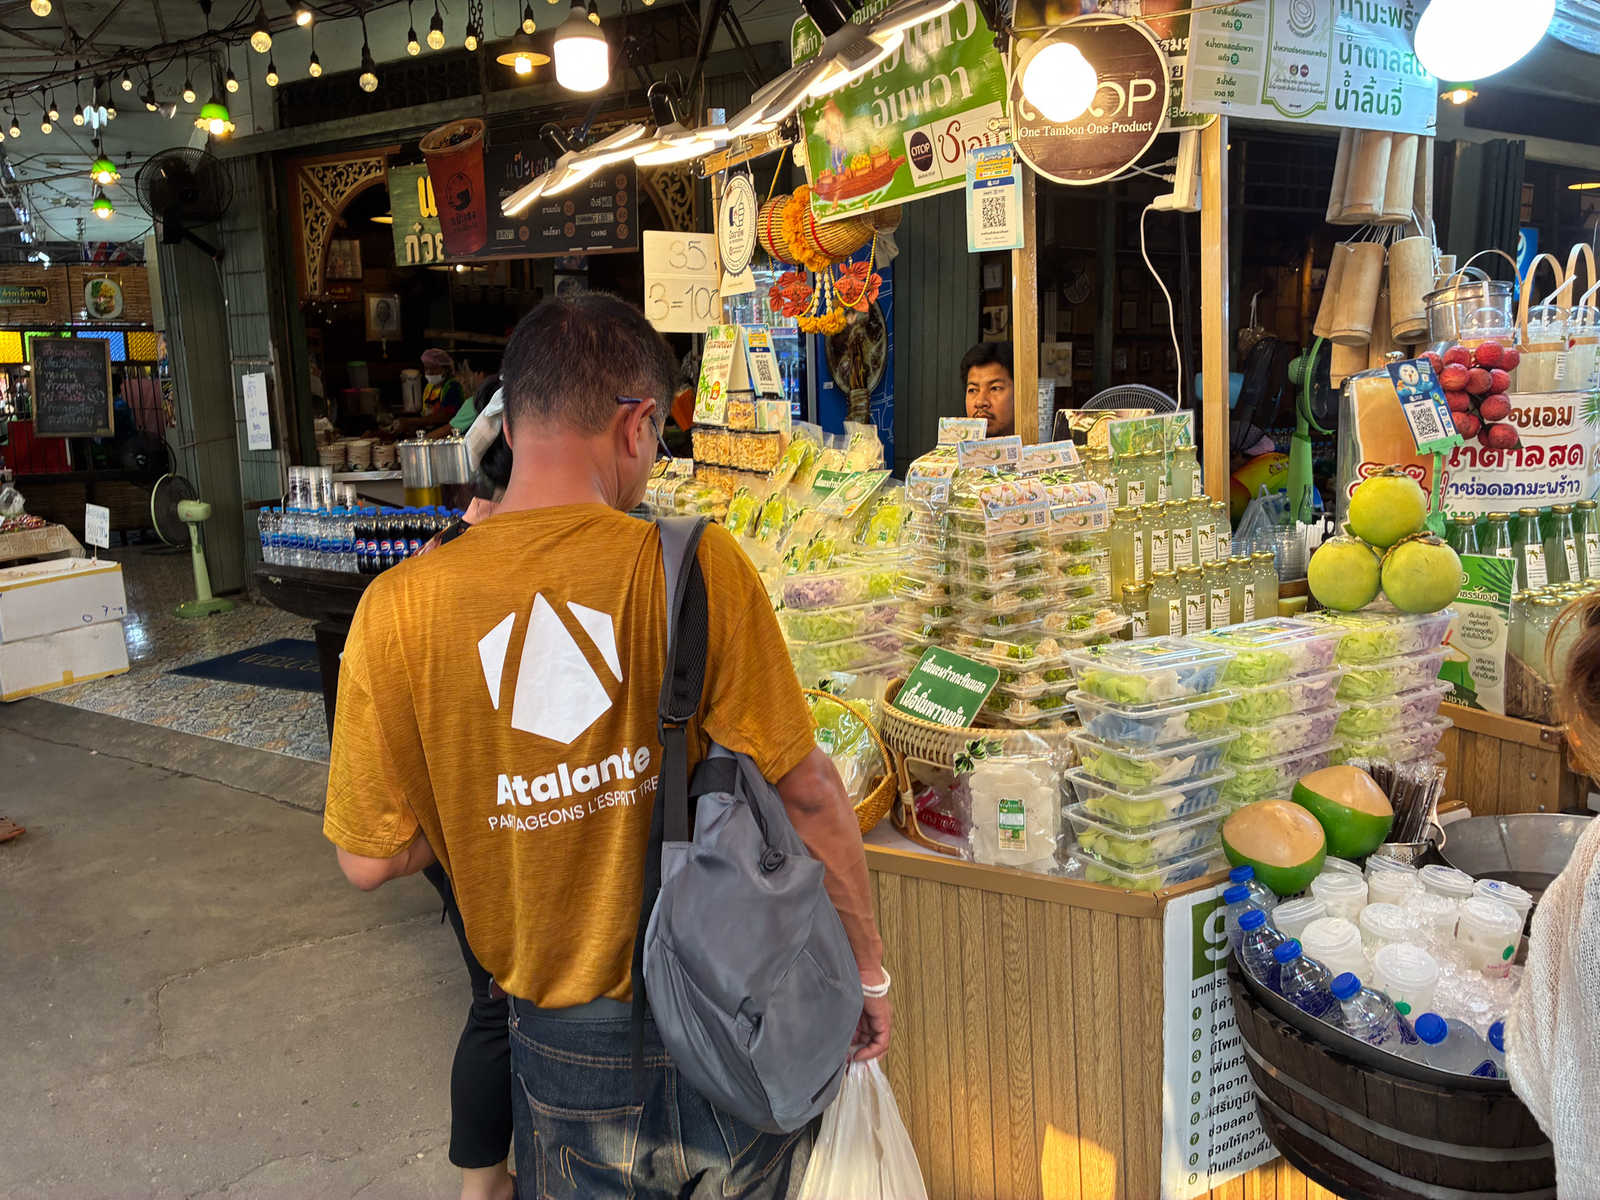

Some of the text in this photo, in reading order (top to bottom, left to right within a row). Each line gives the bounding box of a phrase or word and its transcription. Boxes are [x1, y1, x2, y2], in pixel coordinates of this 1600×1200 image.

[871, 65, 974, 129] อัมพวา
[1018, 78, 1157, 121] OP
[1335, 70, 1402, 116] น้ำลิ้นจี่
[1019, 120, 1153, 138] One Tambon One Product
[911, 142, 931, 157] OTOP
[668, 240, 707, 271] 35
[1447, 474, 1581, 496] าช่อดอกมะพร้าว
[496, 746, 650, 807] Atalante
[639, 774, 660, 798] TRE
[1203, 905, 1235, 962] 9
[1191, 977, 1228, 1000] มากประ
[1210, 996, 1233, 1014] มีค่า
[1210, 1015, 1236, 1036] อุดม
[1210, 1036, 1242, 1057] มีโพแ
[1209, 1055, 1246, 1077] เพิ่มคว
[1209, 1074, 1248, 1097] ลดอาก
[1208, 1110, 1257, 1137] ช่วยลดอ
[1207, 1127, 1264, 1158] ช่วยให้ควา
